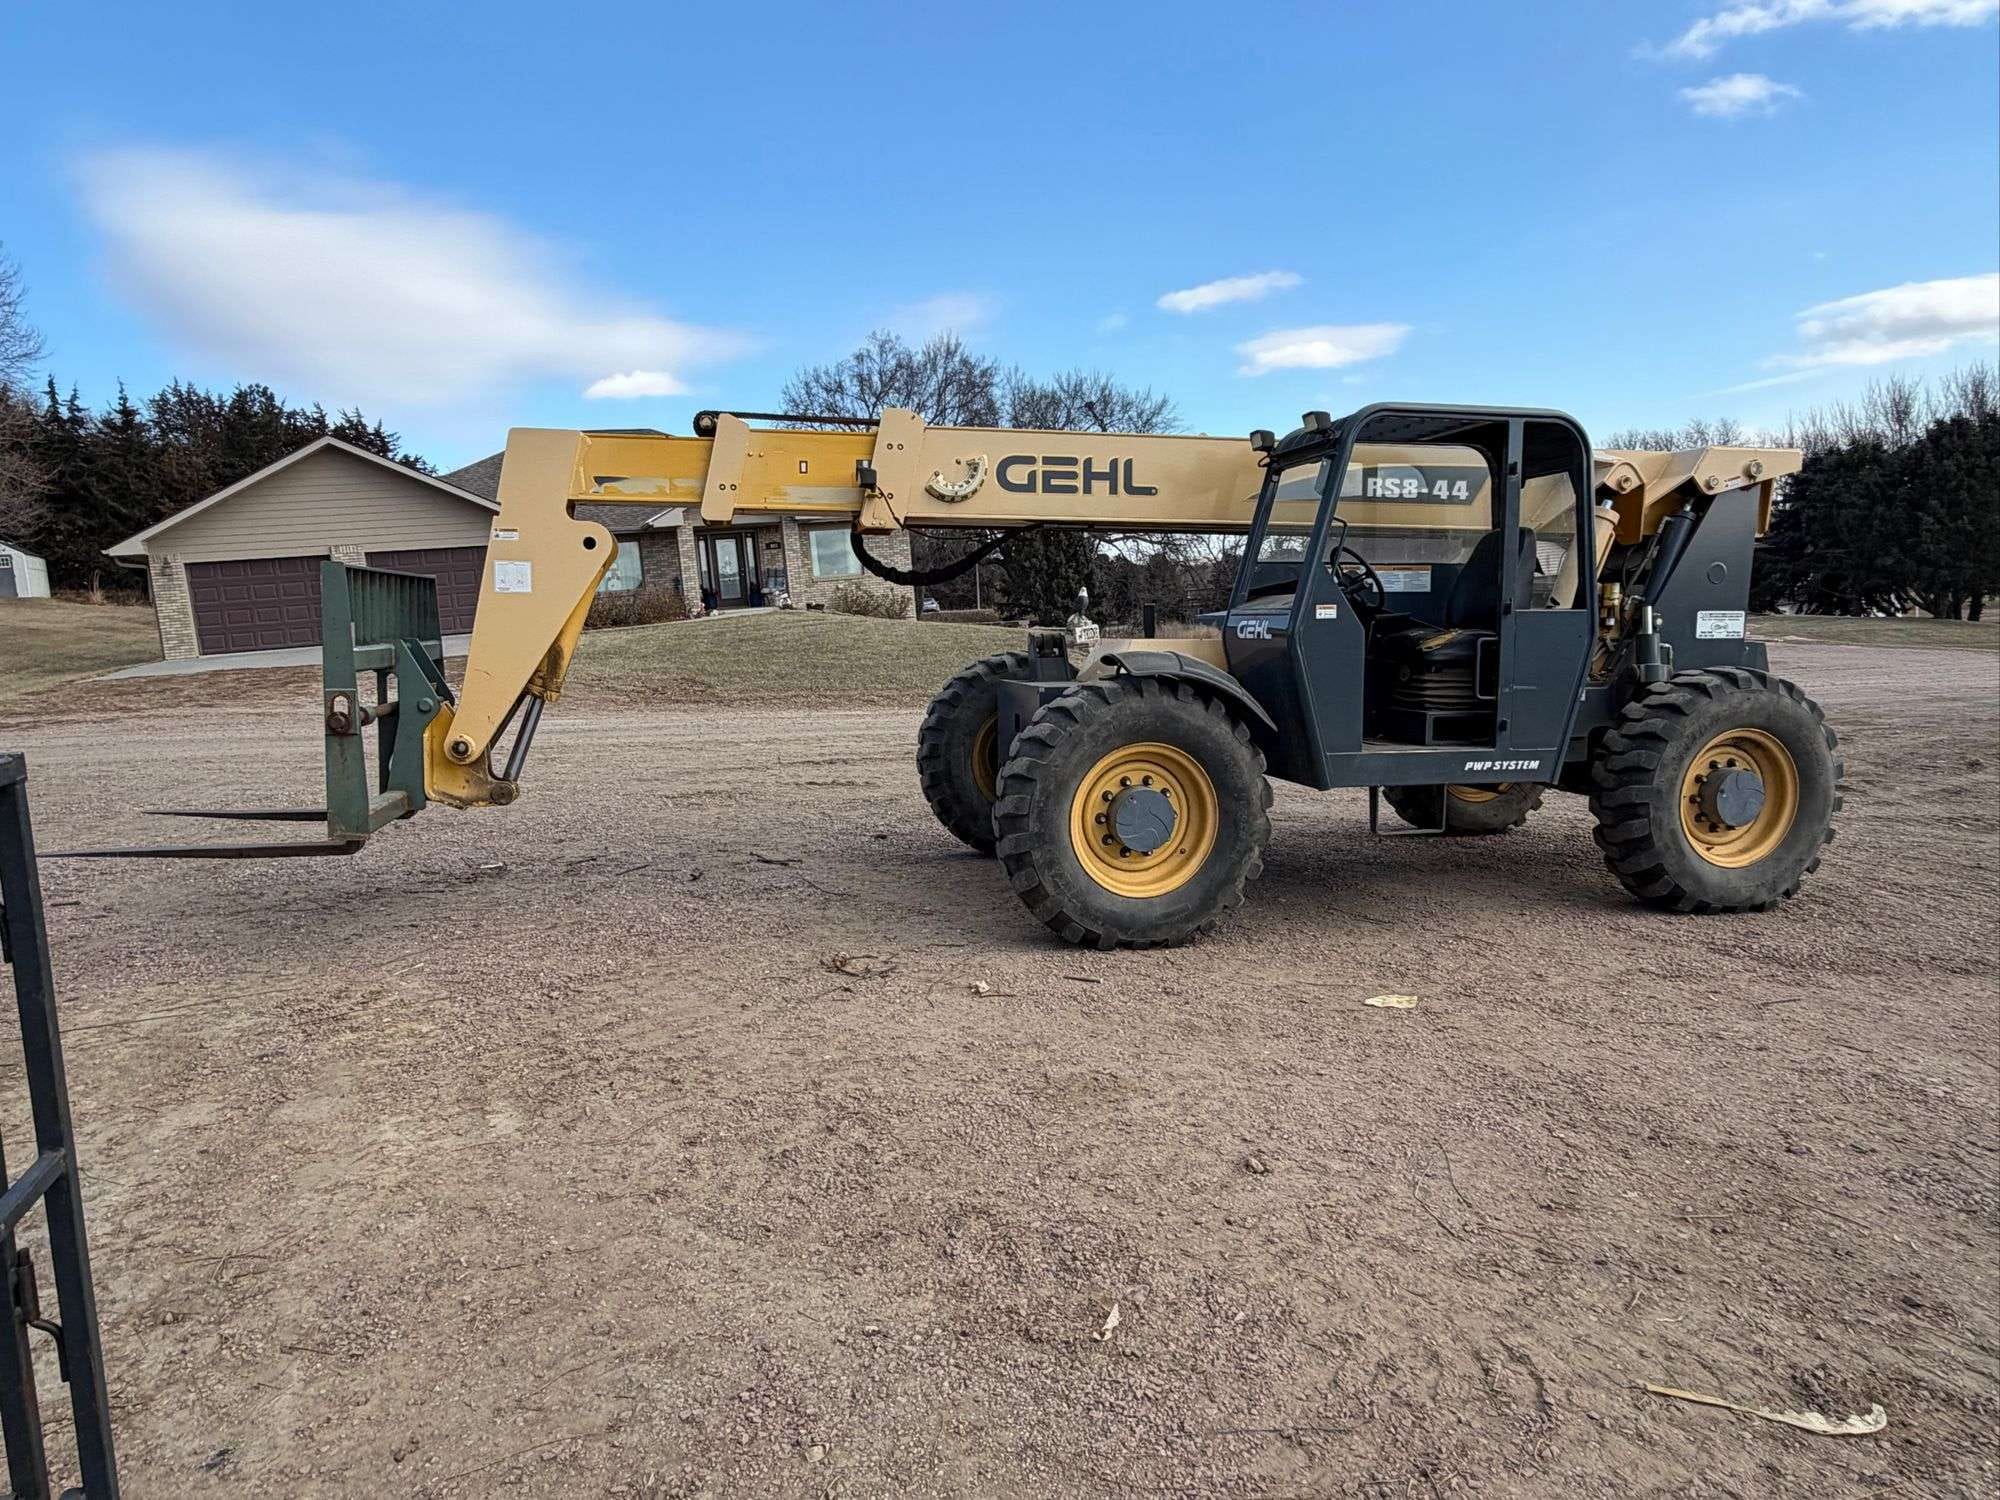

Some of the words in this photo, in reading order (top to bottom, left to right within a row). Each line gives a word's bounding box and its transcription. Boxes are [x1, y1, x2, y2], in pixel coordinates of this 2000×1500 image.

[996, 455, 1158, 496] GEHL
[1367, 478, 1469, 500] RS8-44
[1237, 620, 1272, 640] GEHL
[1464, 761, 1492, 771] PWP
[1493, 760, 1540, 770] SYSTEM
